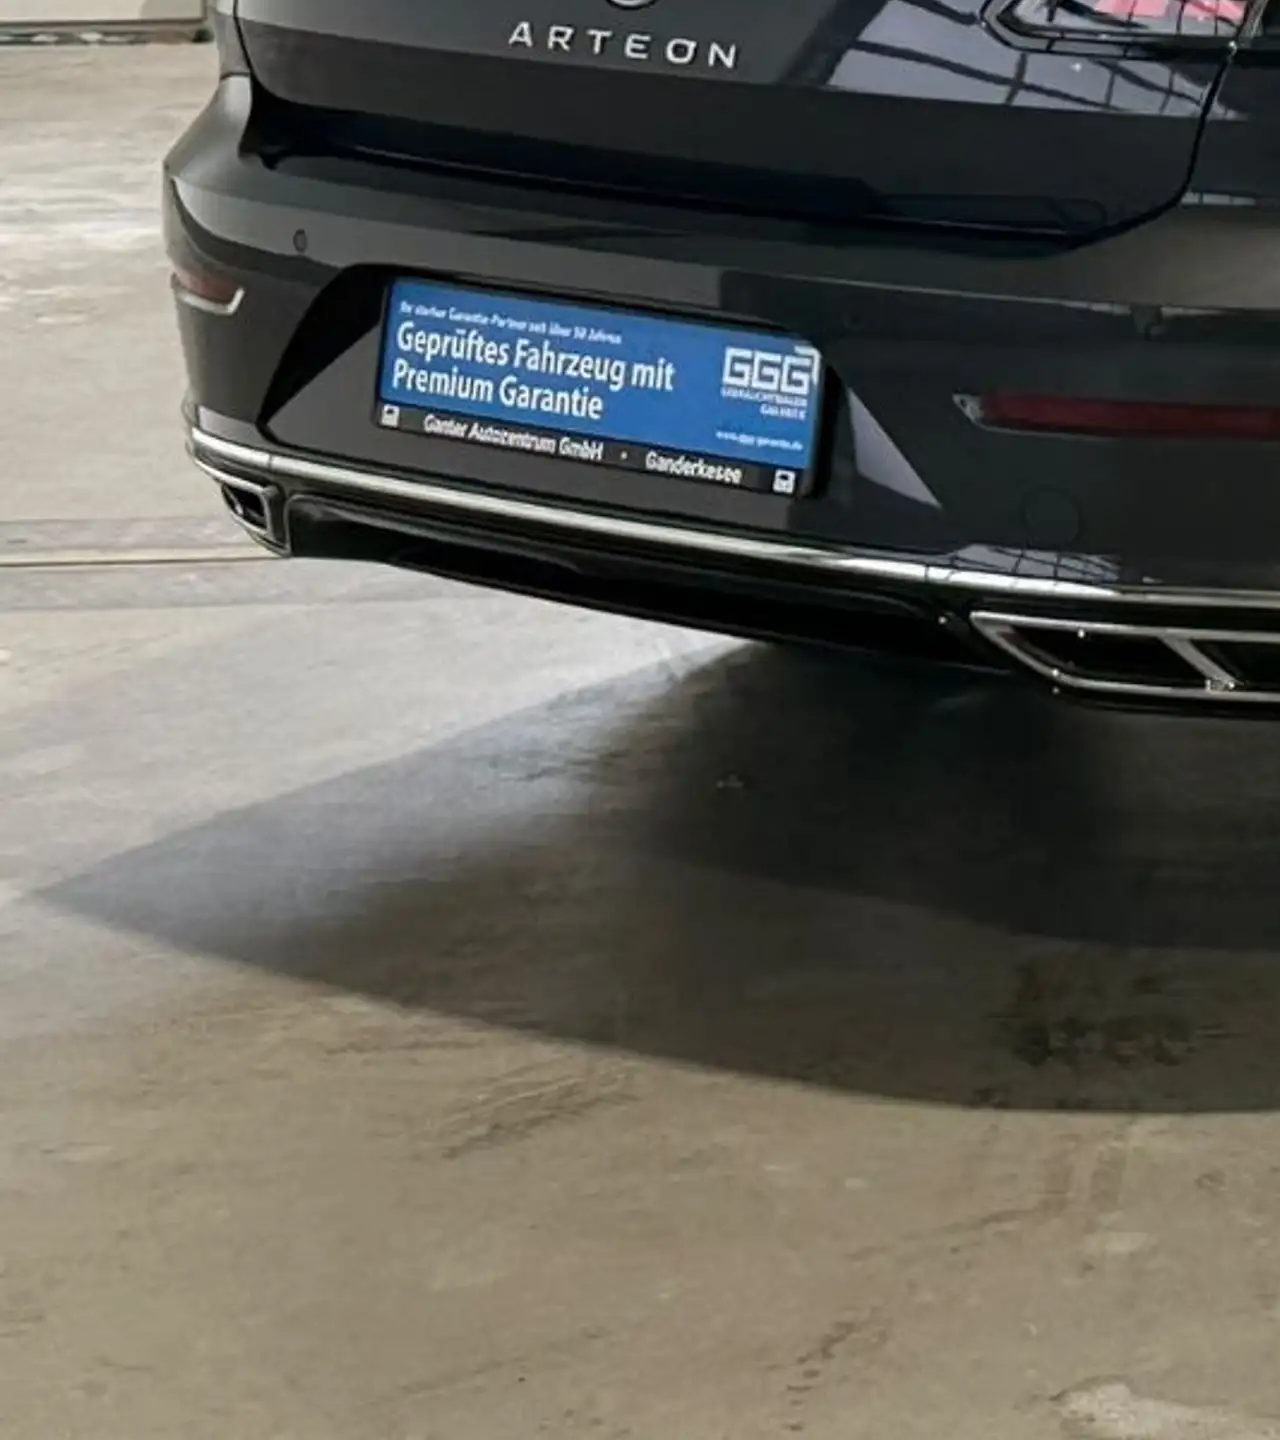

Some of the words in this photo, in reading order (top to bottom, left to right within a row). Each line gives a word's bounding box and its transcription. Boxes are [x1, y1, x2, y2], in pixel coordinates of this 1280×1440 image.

[508, 20, 736, 69] ARTEON
[397, 321, 510, 367] Geprüftes
[513, 337, 627, 393] Fahrzeug
[632, 356, 677, 392] mit
[722, 346, 811, 396] GGG
[392, 359, 494, 404] Premium
[499, 375, 604, 420] Garantie
[423, 413, 468, 438] Ganter
[559, 435, 605, 461] GmbH
[645, 450, 742, 485] Ganderkesee
